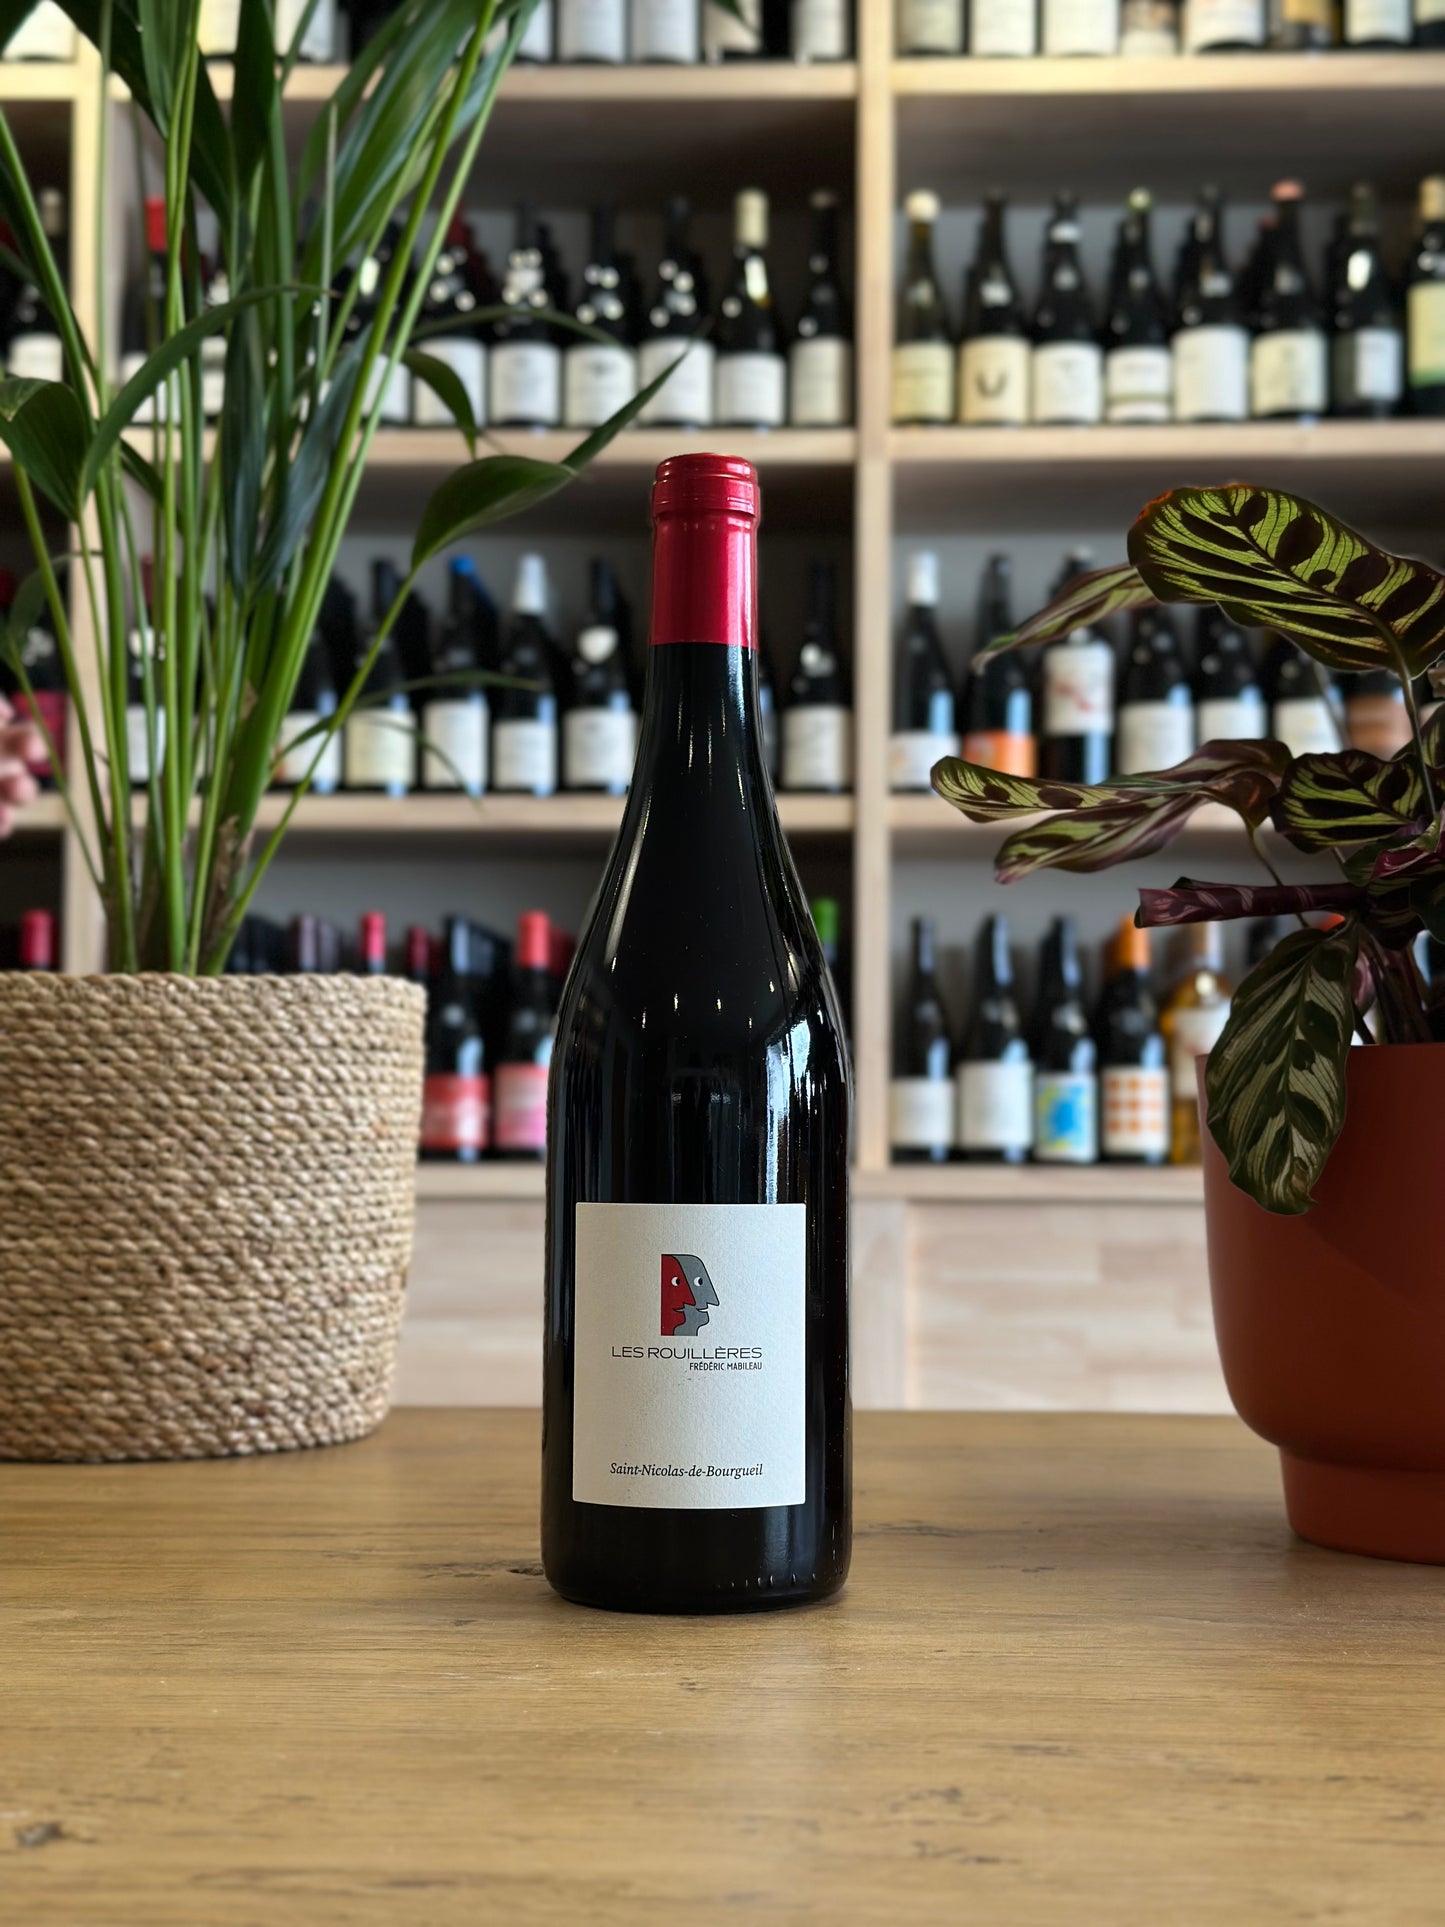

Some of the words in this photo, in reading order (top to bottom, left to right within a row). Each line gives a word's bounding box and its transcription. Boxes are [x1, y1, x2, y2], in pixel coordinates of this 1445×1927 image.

[611, 1346, 644, 1359] LES
[647, 1345, 763, 1360] ROUILLÈRES
[689, 1361, 725, 1371] FRÉDÉRIC
[726, 1361, 763, 1371] MABILEAU
[610, 1462, 763, 1480] Saint-Nicolas-de-Bourgueil
